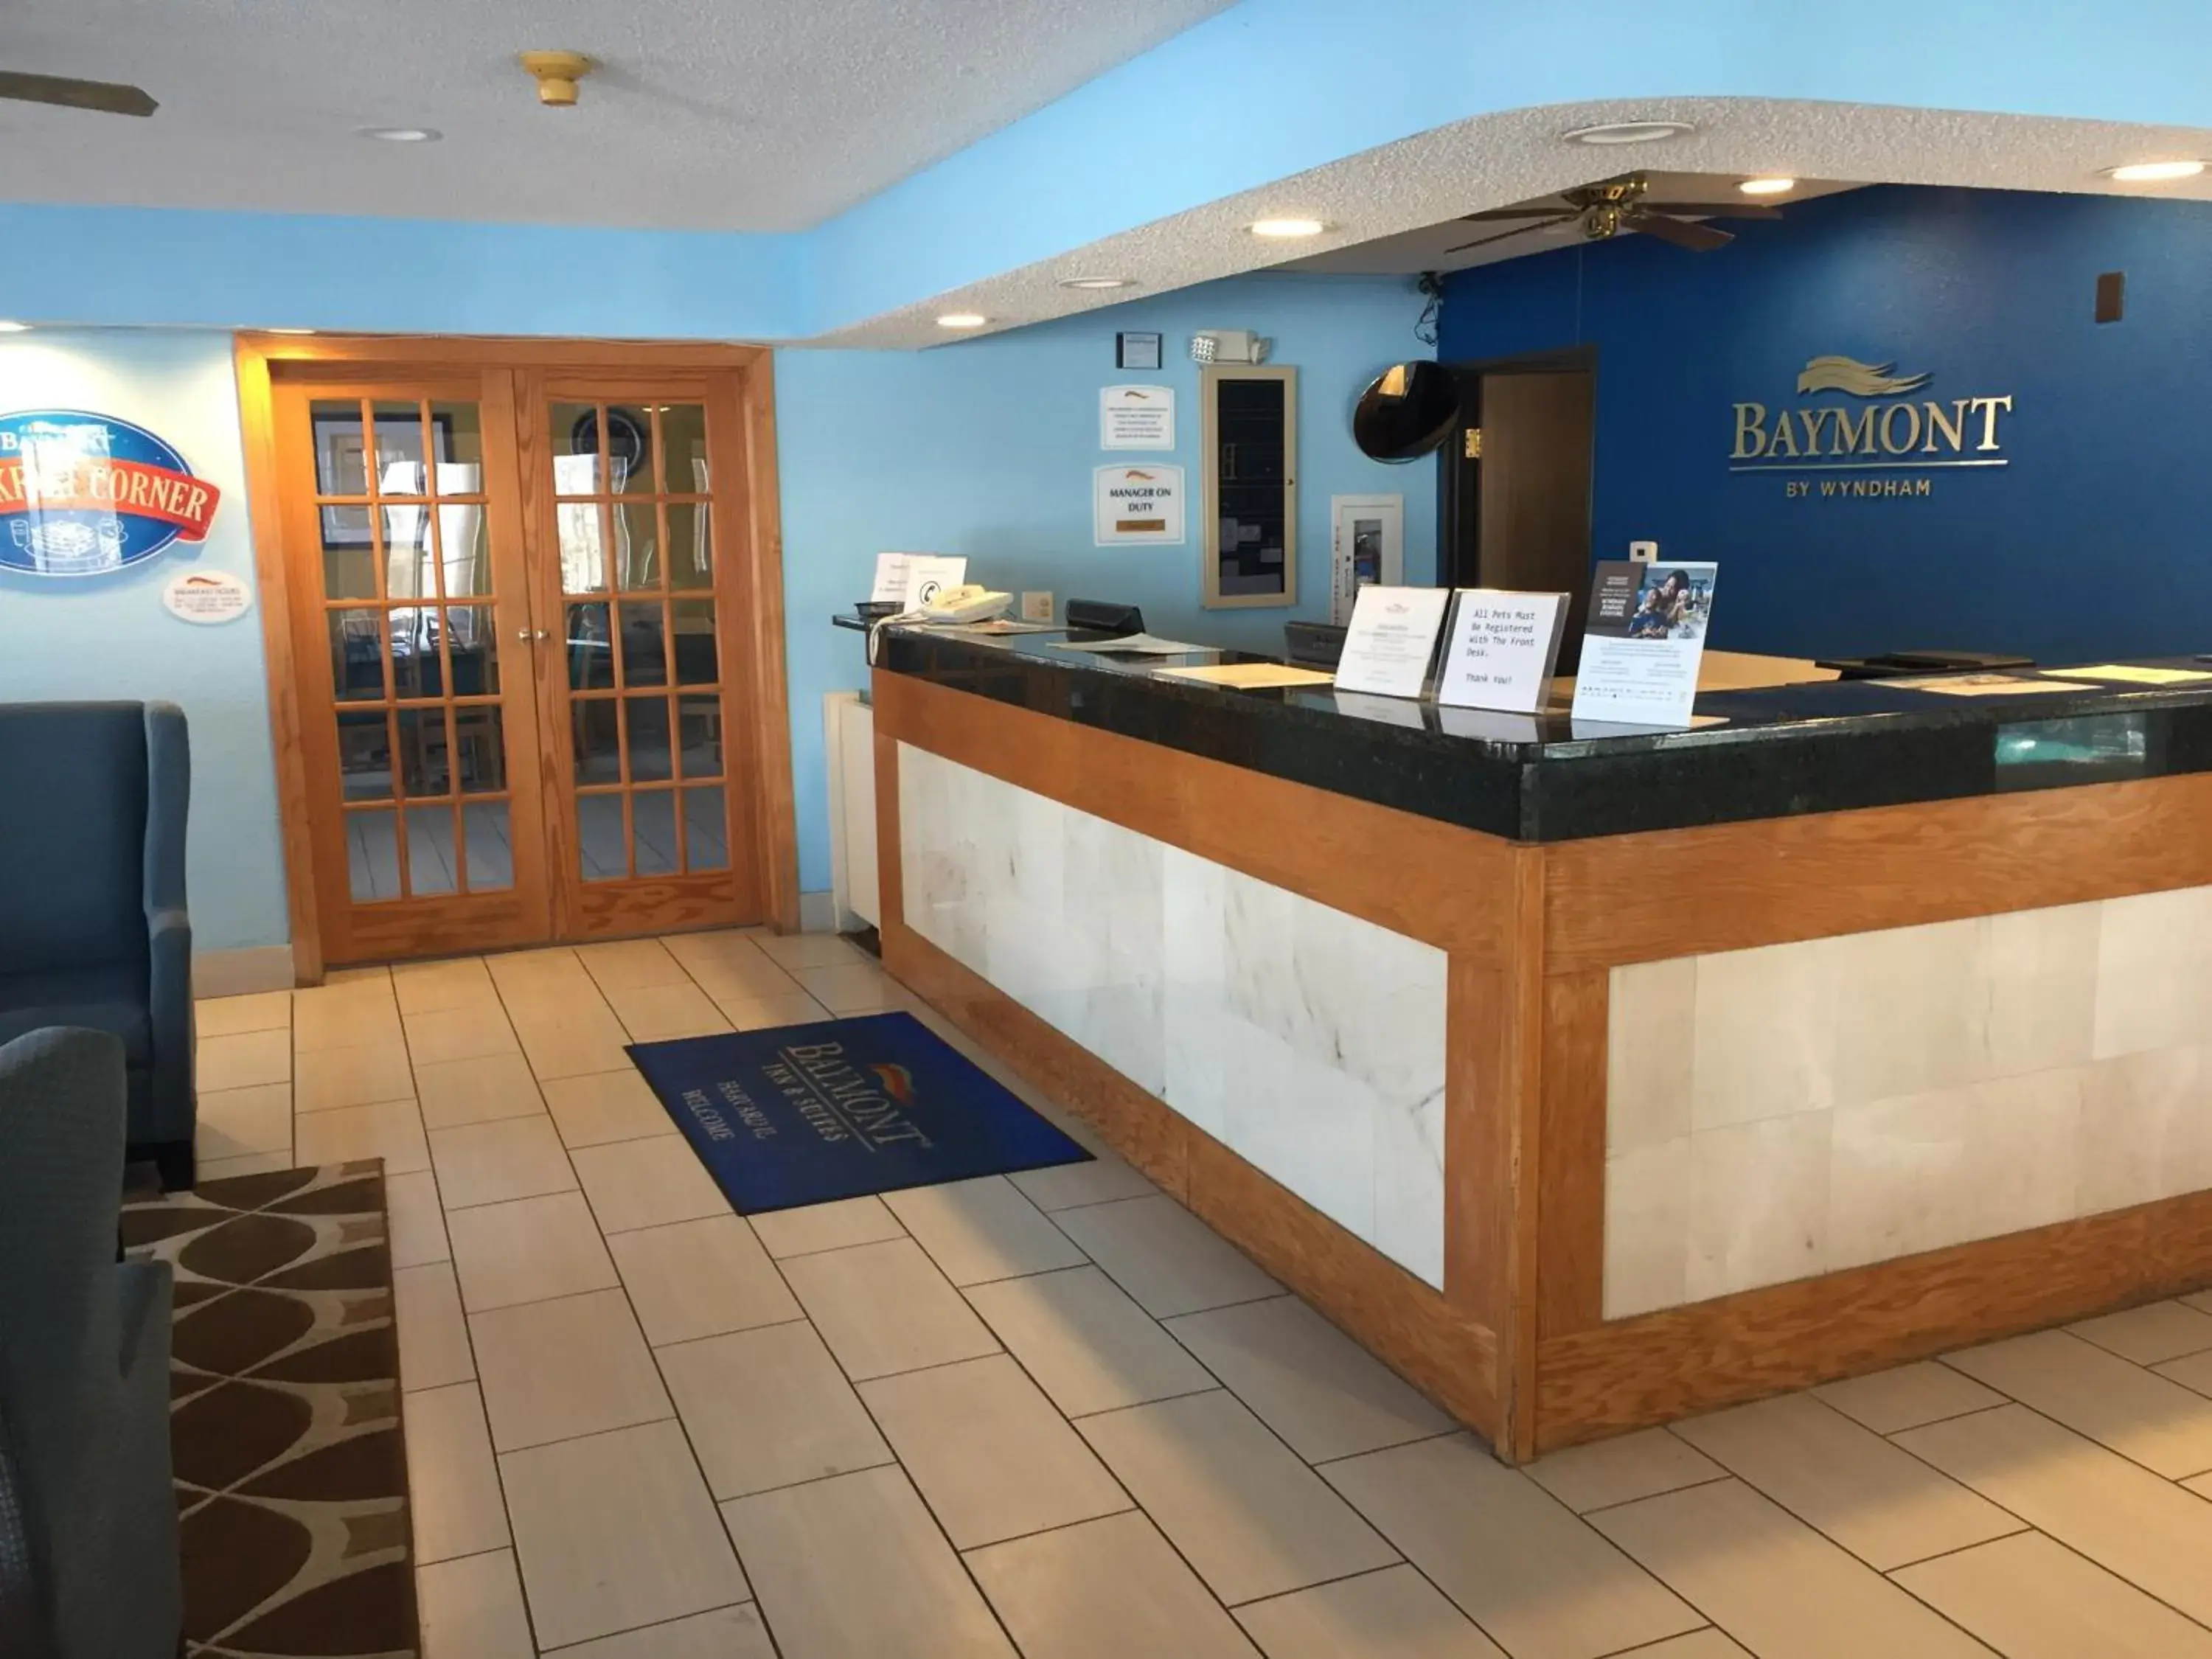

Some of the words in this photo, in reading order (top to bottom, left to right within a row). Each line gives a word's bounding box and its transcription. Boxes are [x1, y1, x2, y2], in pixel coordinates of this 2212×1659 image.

[1729, 395, 2012, 459] BAYMONT
[89, 466, 208, 521] CORNER
[1110, 488, 1154, 498] MANAGER
[1155, 487, 1172, 497] ON
[1787, 481, 1810, 498] BY
[1820, 479, 1931, 497] WYNDHAM
[1128, 502, 1153, 512] DUTY
[1474, 608, 1487, 619] All
[1492, 610, 1512, 619] Pets
[1515, 611, 1535, 620] Must
[1485, 622, 1533, 634] Registered
[1493, 636, 1506, 644] The
[1510, 636, 1534, 646] Front
[1467, 673, 1488, 682] Thank
[786, 1041, 926, 1144] BAYMONT
[762, 1063, 798, 1085] INN
[793, 1098, 849, 1141] SUITES
[681, 1088, 735, 1141] WELCOME
